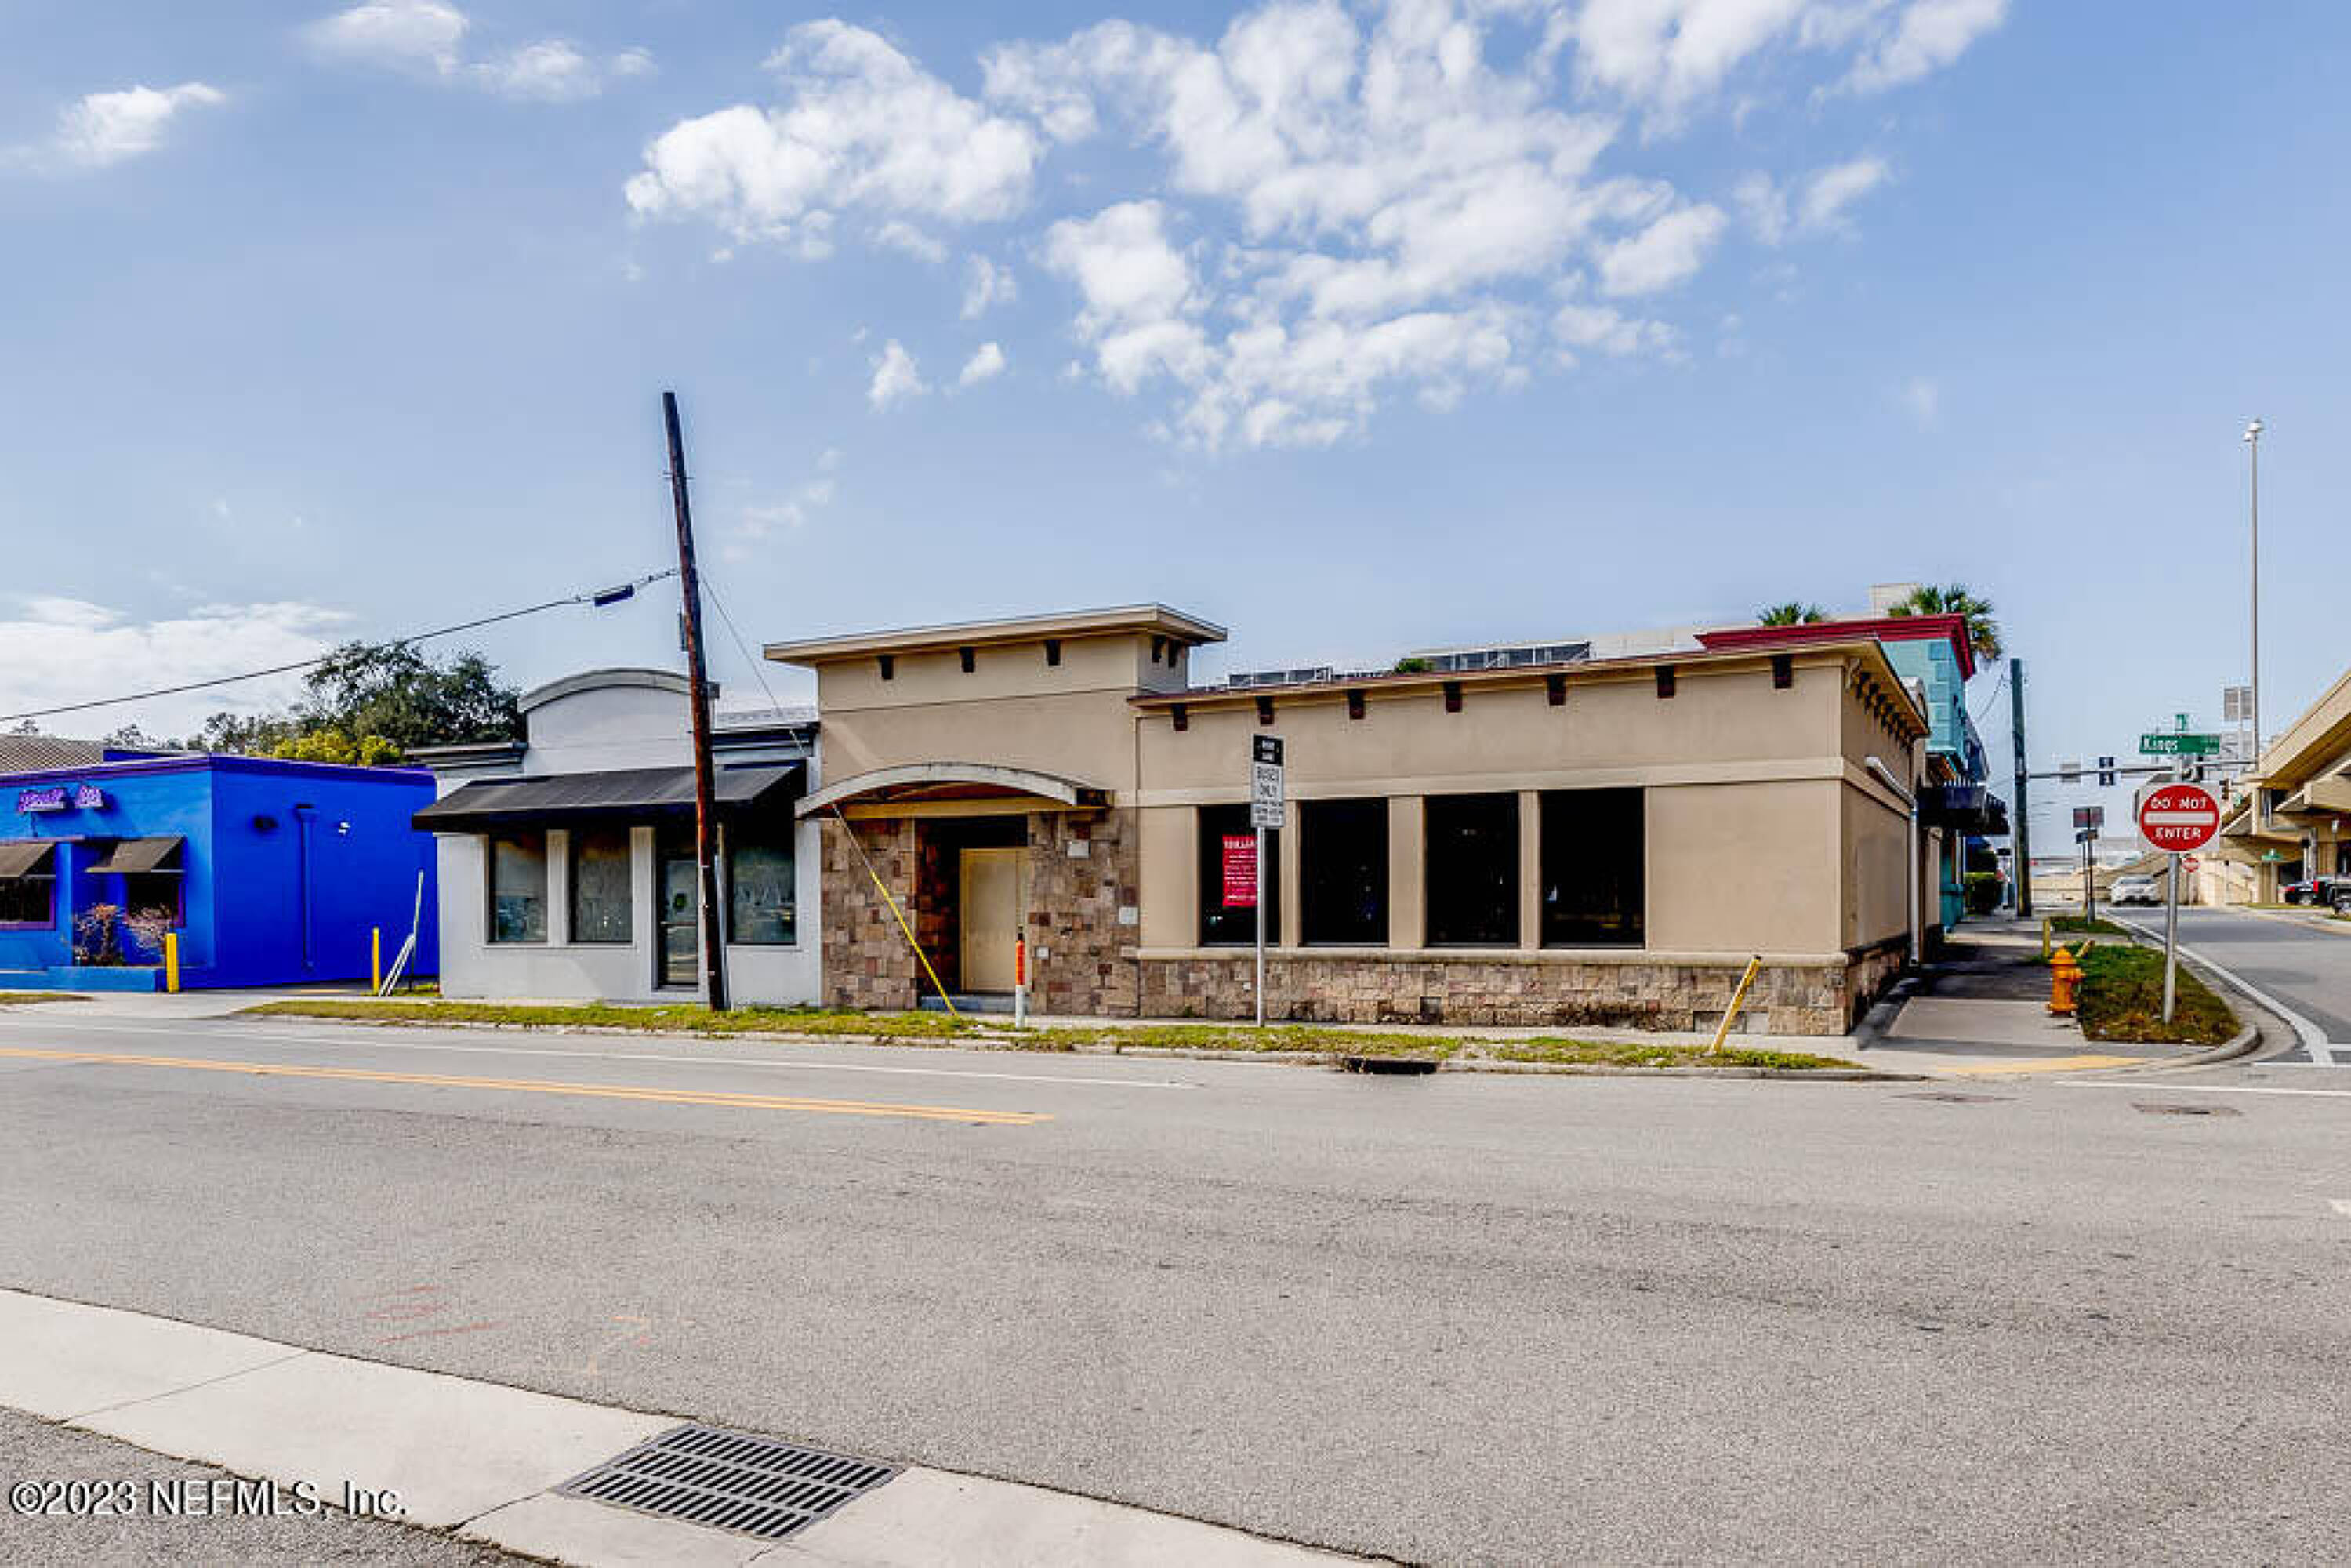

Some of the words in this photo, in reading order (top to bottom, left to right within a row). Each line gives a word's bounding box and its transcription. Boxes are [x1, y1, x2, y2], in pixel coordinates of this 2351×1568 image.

[2150, 796, 2171, 810] DO
[2179, 797, 2208, 809] NOT
[2155, 826, 2202, 840] ENTER
